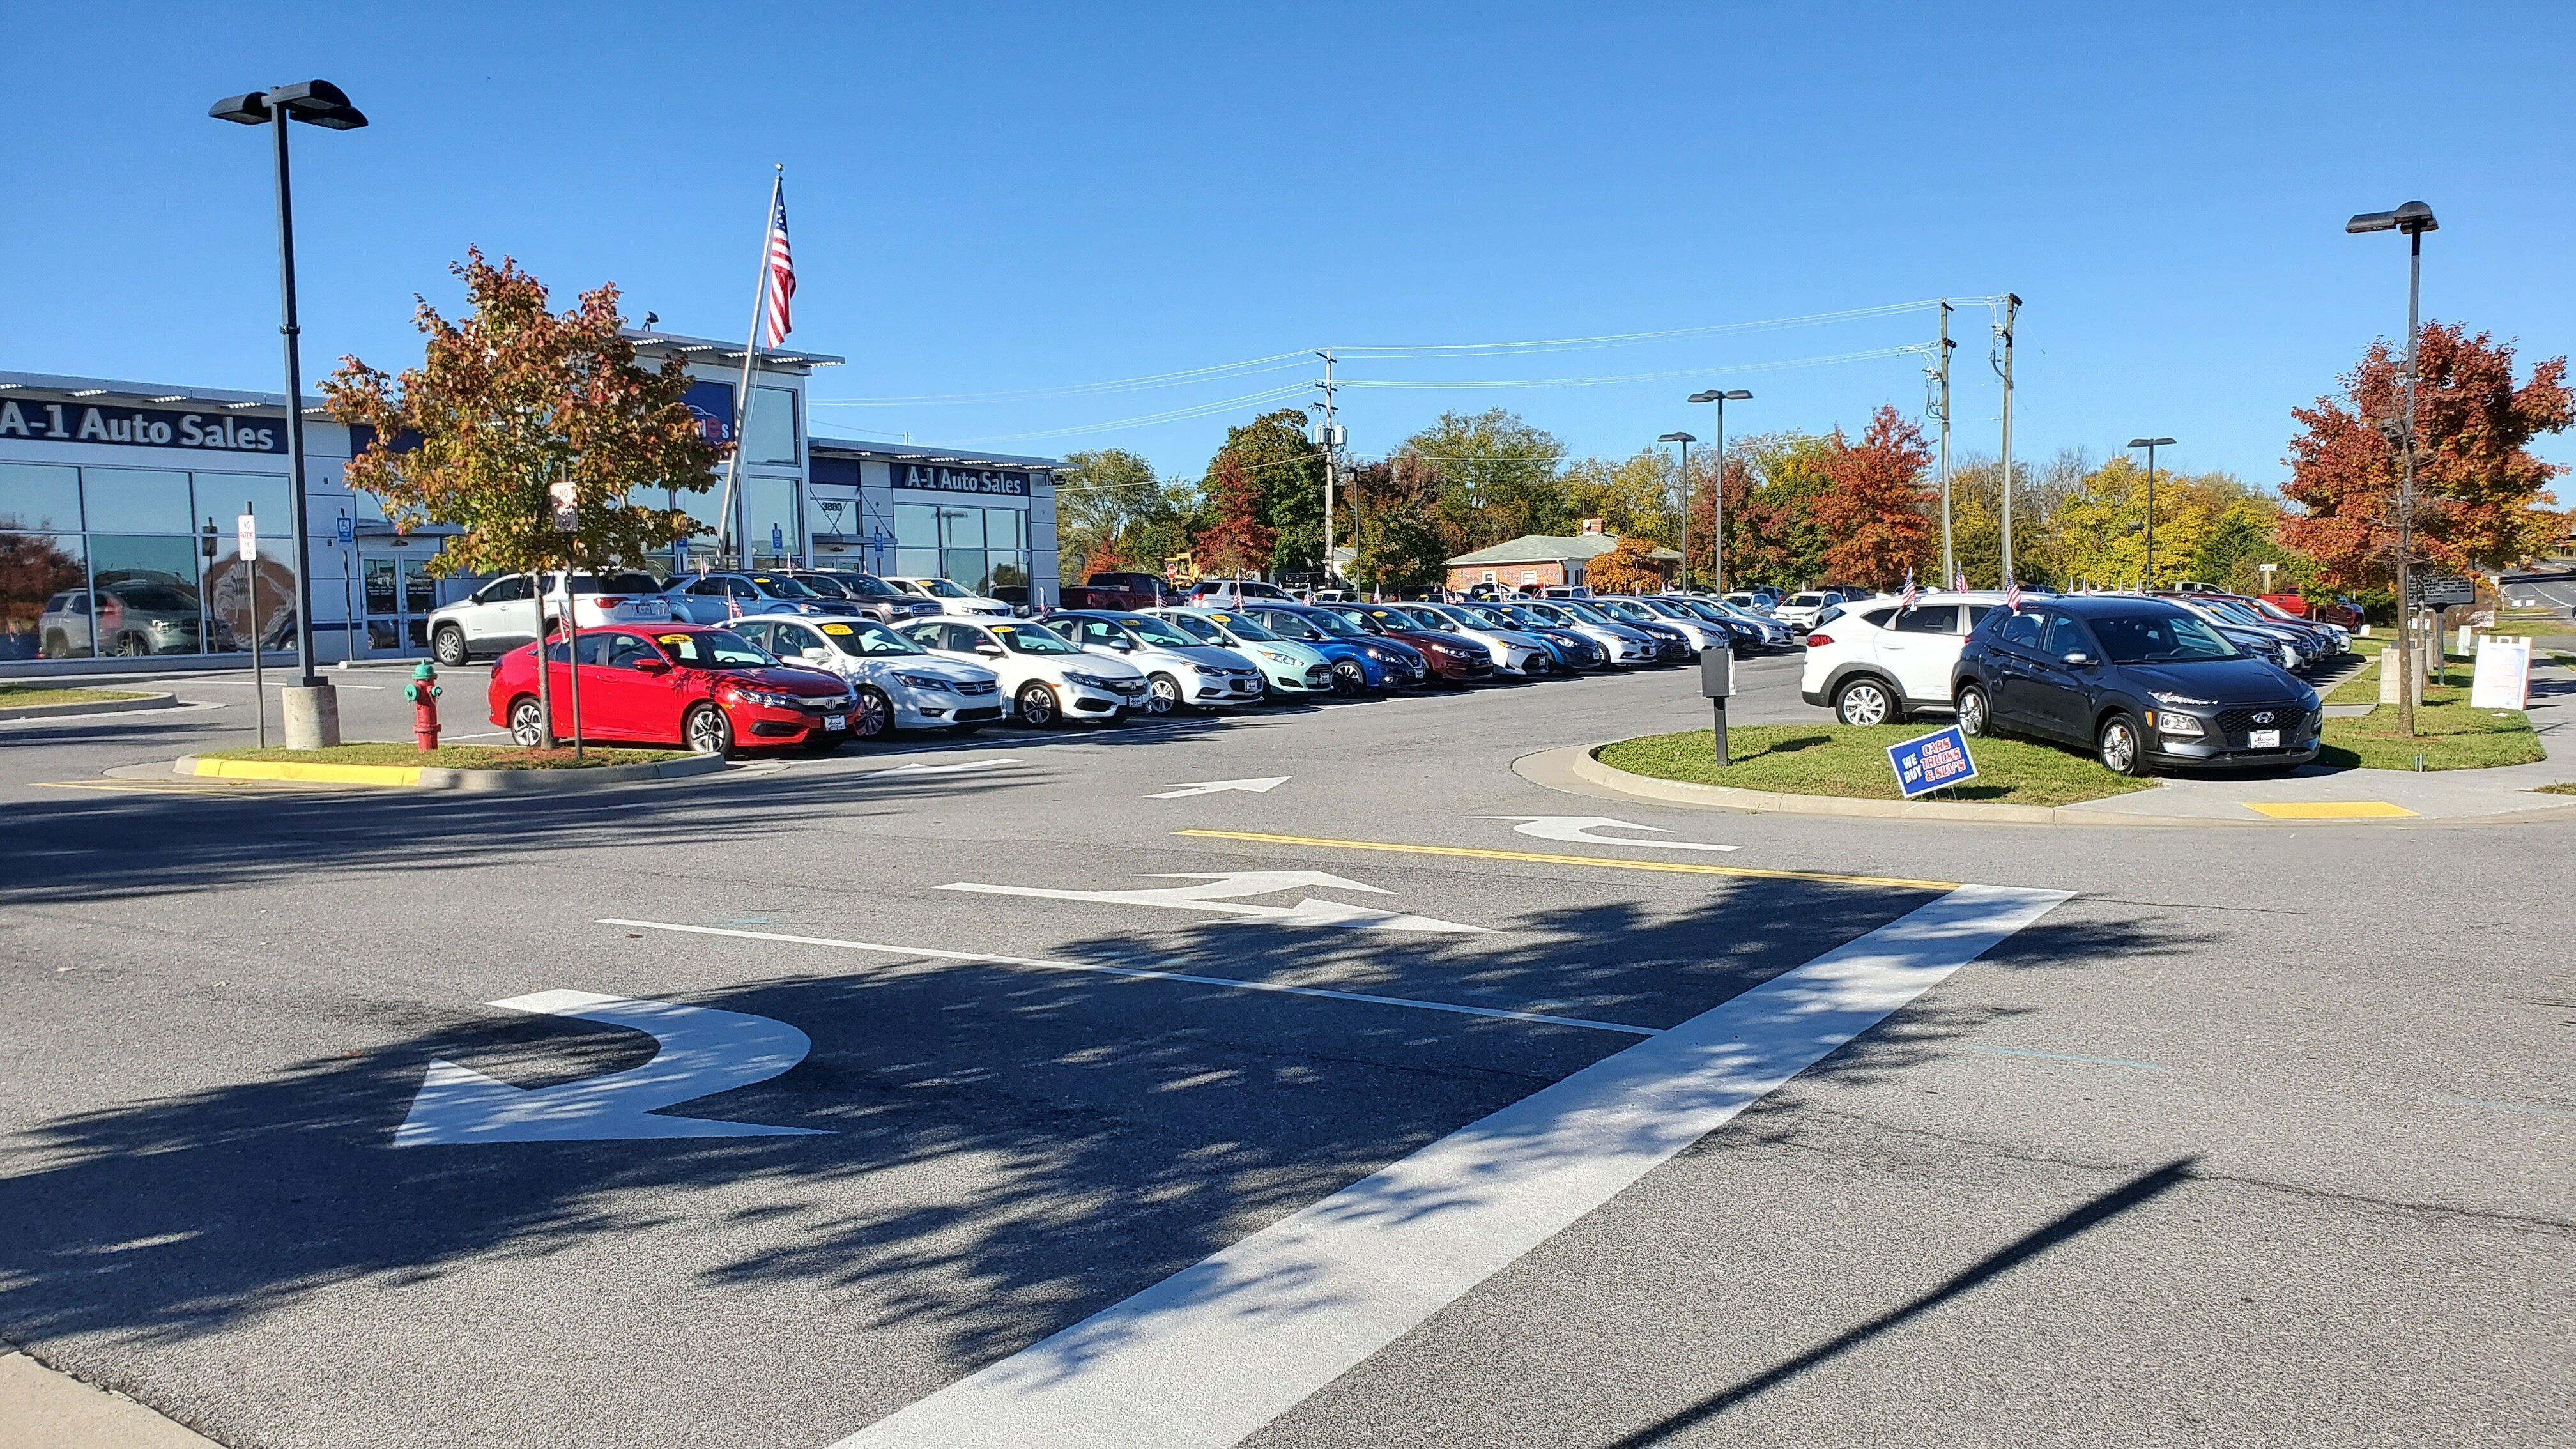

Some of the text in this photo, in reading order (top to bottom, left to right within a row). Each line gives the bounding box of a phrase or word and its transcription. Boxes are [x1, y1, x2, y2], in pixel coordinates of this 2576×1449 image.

[0, 401, 273, 450] A-1 Auto Sales
[905, 466, 1021, 494] A-1 Auto Sales
[559, 489, 569, 498] NO
[822, 502, 843, 512] 3880
[243, 521, 250, 530] NO
[1922, 737, 1951, 756] CARS
[1901, 753, 1918, 770] WE
[1920, 747, 1961, 770] TRUCKS
[1903, 764, 1922, 784] BUY
[1925, 758, 1966, 782] & SUV'S
